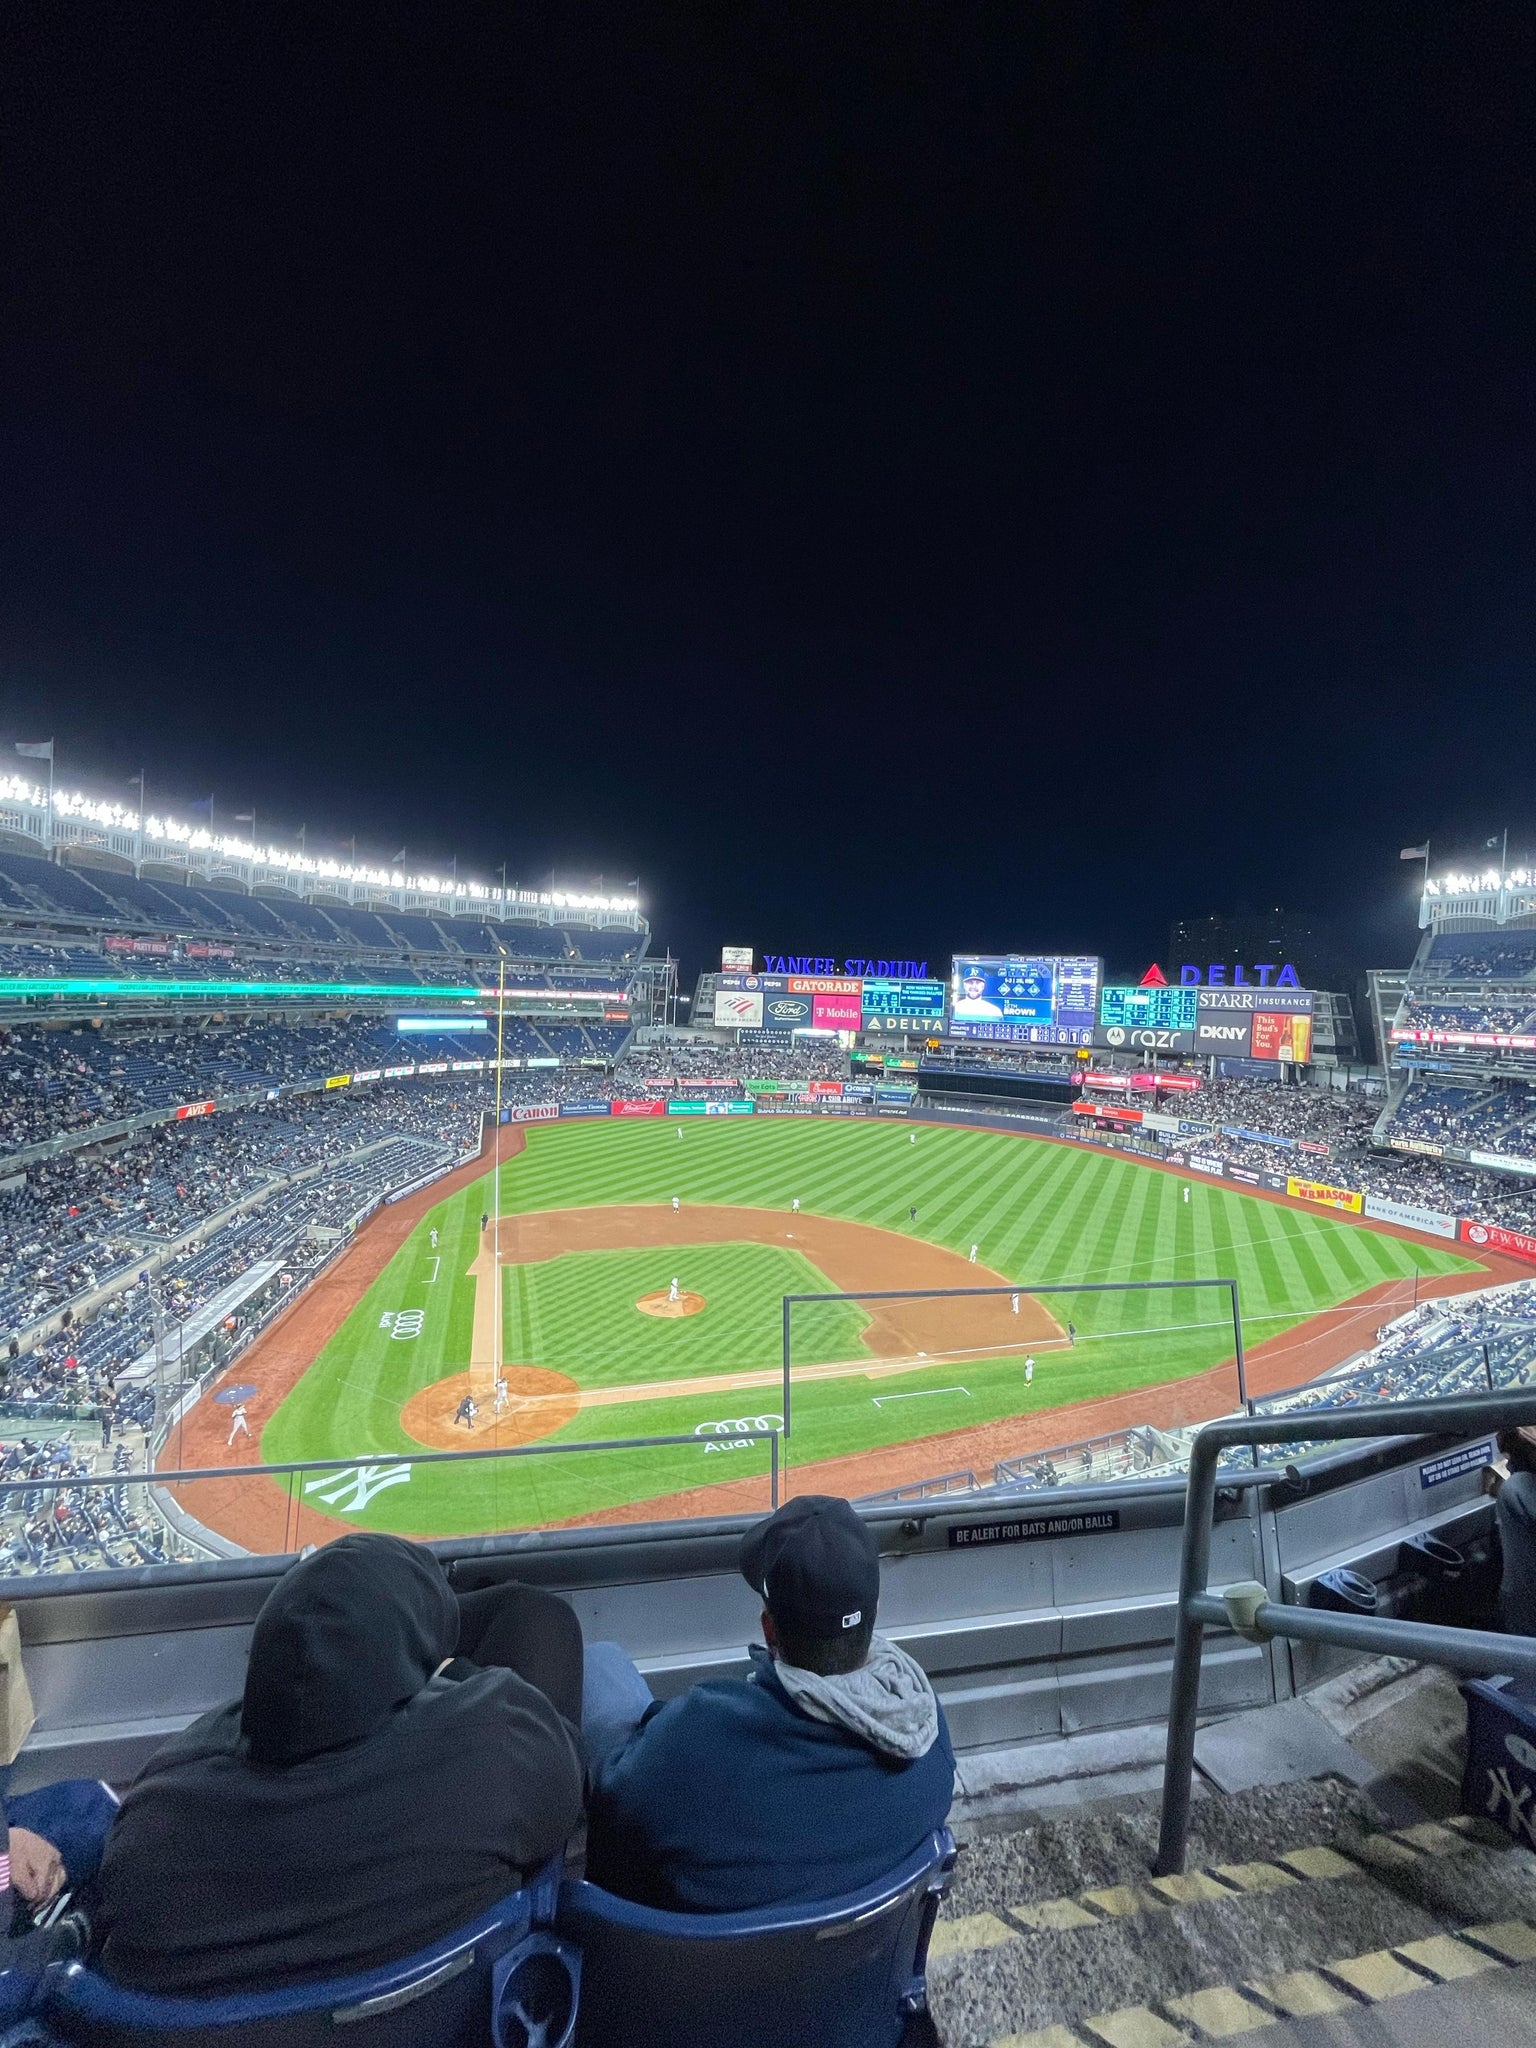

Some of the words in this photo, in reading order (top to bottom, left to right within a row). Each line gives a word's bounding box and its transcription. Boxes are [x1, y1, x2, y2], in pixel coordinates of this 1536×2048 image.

[763, 955, 835, 976] YANKEE
[844, 959, 928, 979] STADIUM
[1180, 963, 1300, 987] DELTA
[792, 981, 859, 993] GATORADE
[1199, 992, 1254, 1008] STARR
[1258, 998, 1311, 1006] INSURANCE
[774, 1002, 802, 1015] Ford
[826, 1008, 858, 1019] Mobile
[1004, 1008, 1036, 1016] BROWN
[886, 1018, 943, 1031] DELTA
[1256, 1016, 1275, 1024] This
[1199, 1025, 1247, 1040] DKNY
[1256, 1024, 1279, 1033] Bud's
[1130, 1030, 1181, 1048] razr
[1255, 1032, 1270, 1040] For
[1255, 1040, 1273, 1048] You.
[185, 1105, 206, 1117] AVIS
[513, 1106, 557, 1120] Canon
[1159, 1131, 1176, 1139] BUILD
[1367, 1204, 1386, 1213] BANK
[1398, 1213, 1434, 1226] AMERICA
[1514, 1236, 1536, 1253] WE
[703, 1438, 755, 1454] Audi
[956, 1530, 970, 1543] BE
[970, 1526, 1000, 1542] ALERT
[1001, 1525, 1021, 1538] FOR
[1022, 1522, 1046, 1536] BATS
[1047, 1517, 1084, 1533] AND/OR
[1084, 1515, 1113, 1529] BALLS
